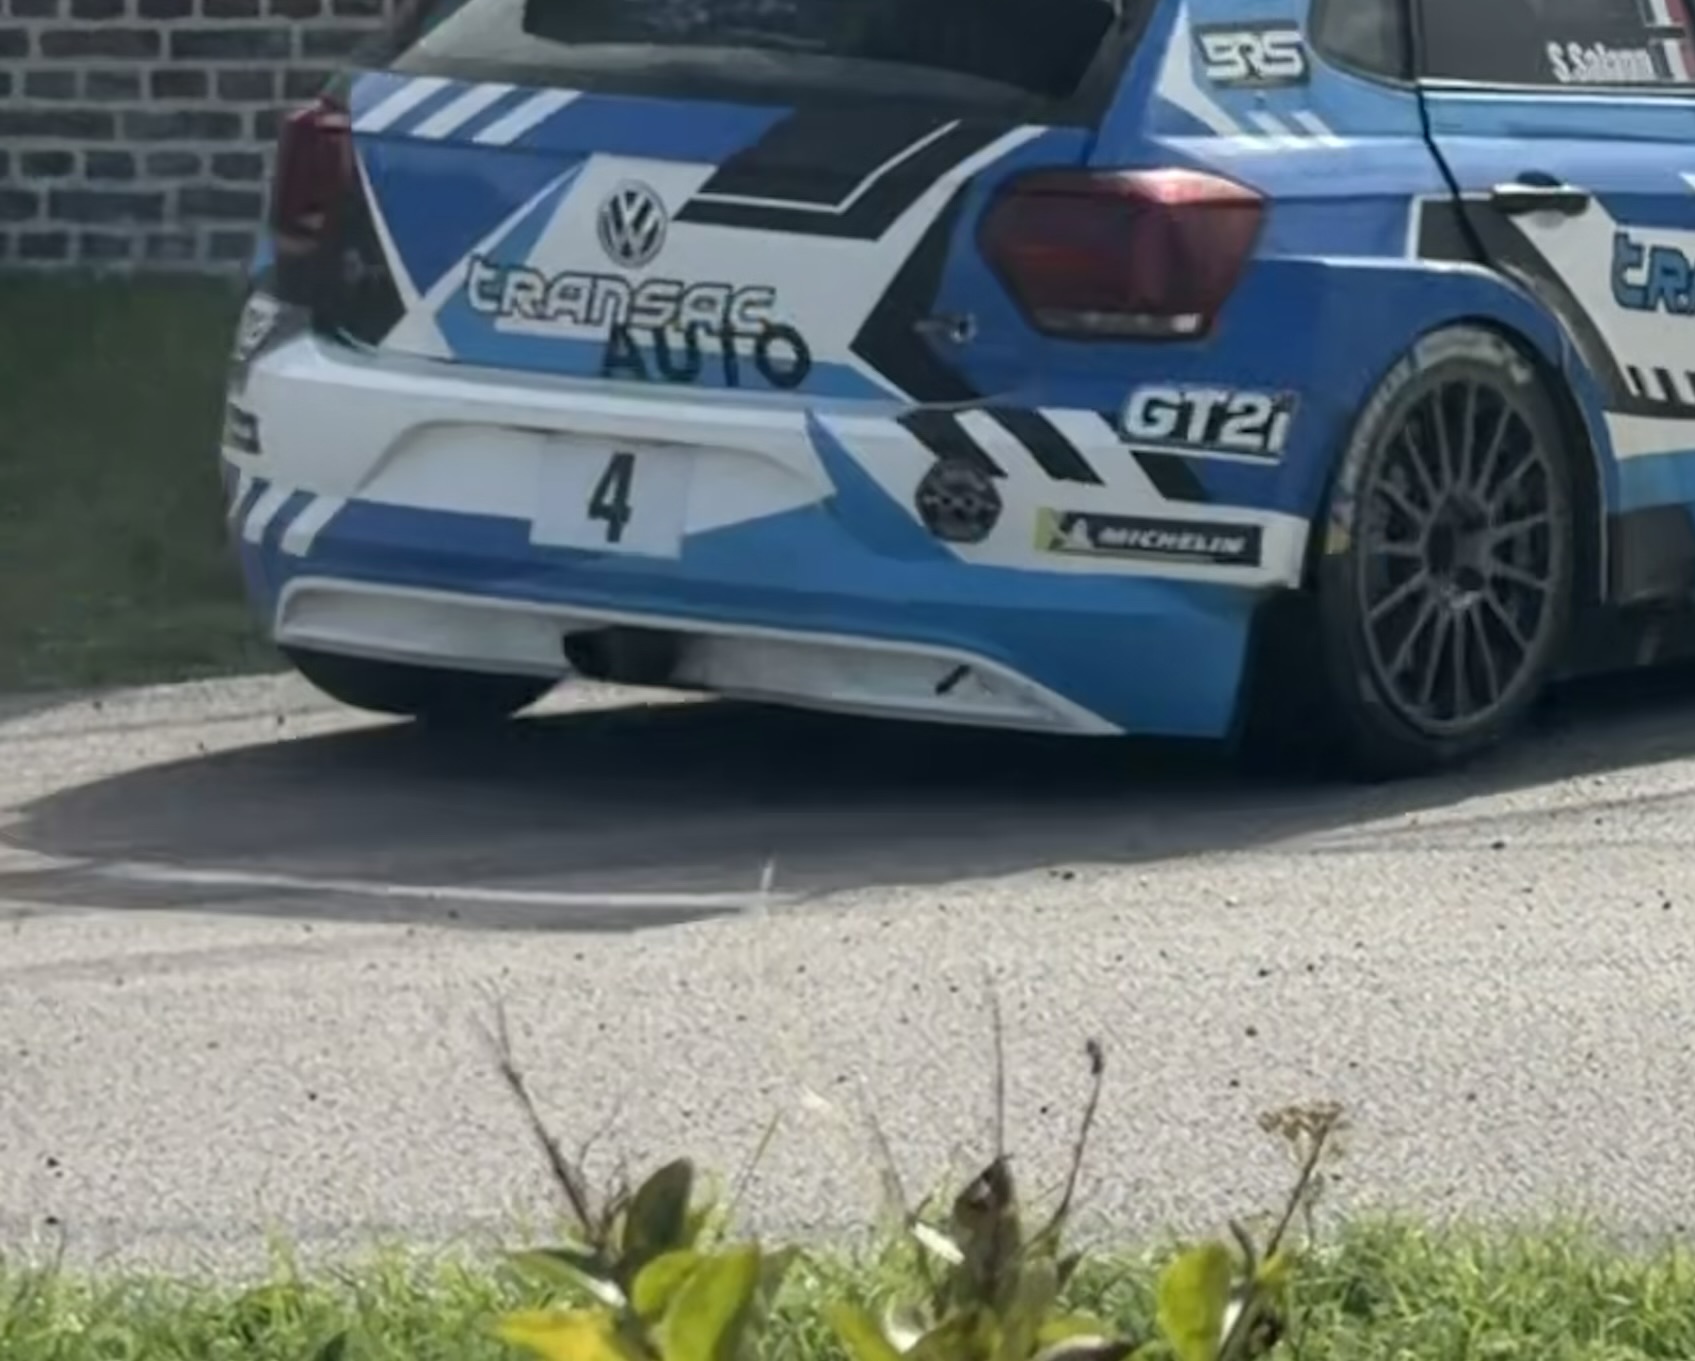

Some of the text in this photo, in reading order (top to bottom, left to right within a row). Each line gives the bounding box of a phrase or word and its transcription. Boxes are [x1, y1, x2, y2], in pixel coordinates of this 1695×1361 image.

[1200, 28, 1308, 83] SRS
[603, 320, 812, 389] AUTO
[587, 451, 636, 544] 4
[1097, 526, 1246, 556] MICHELIN
